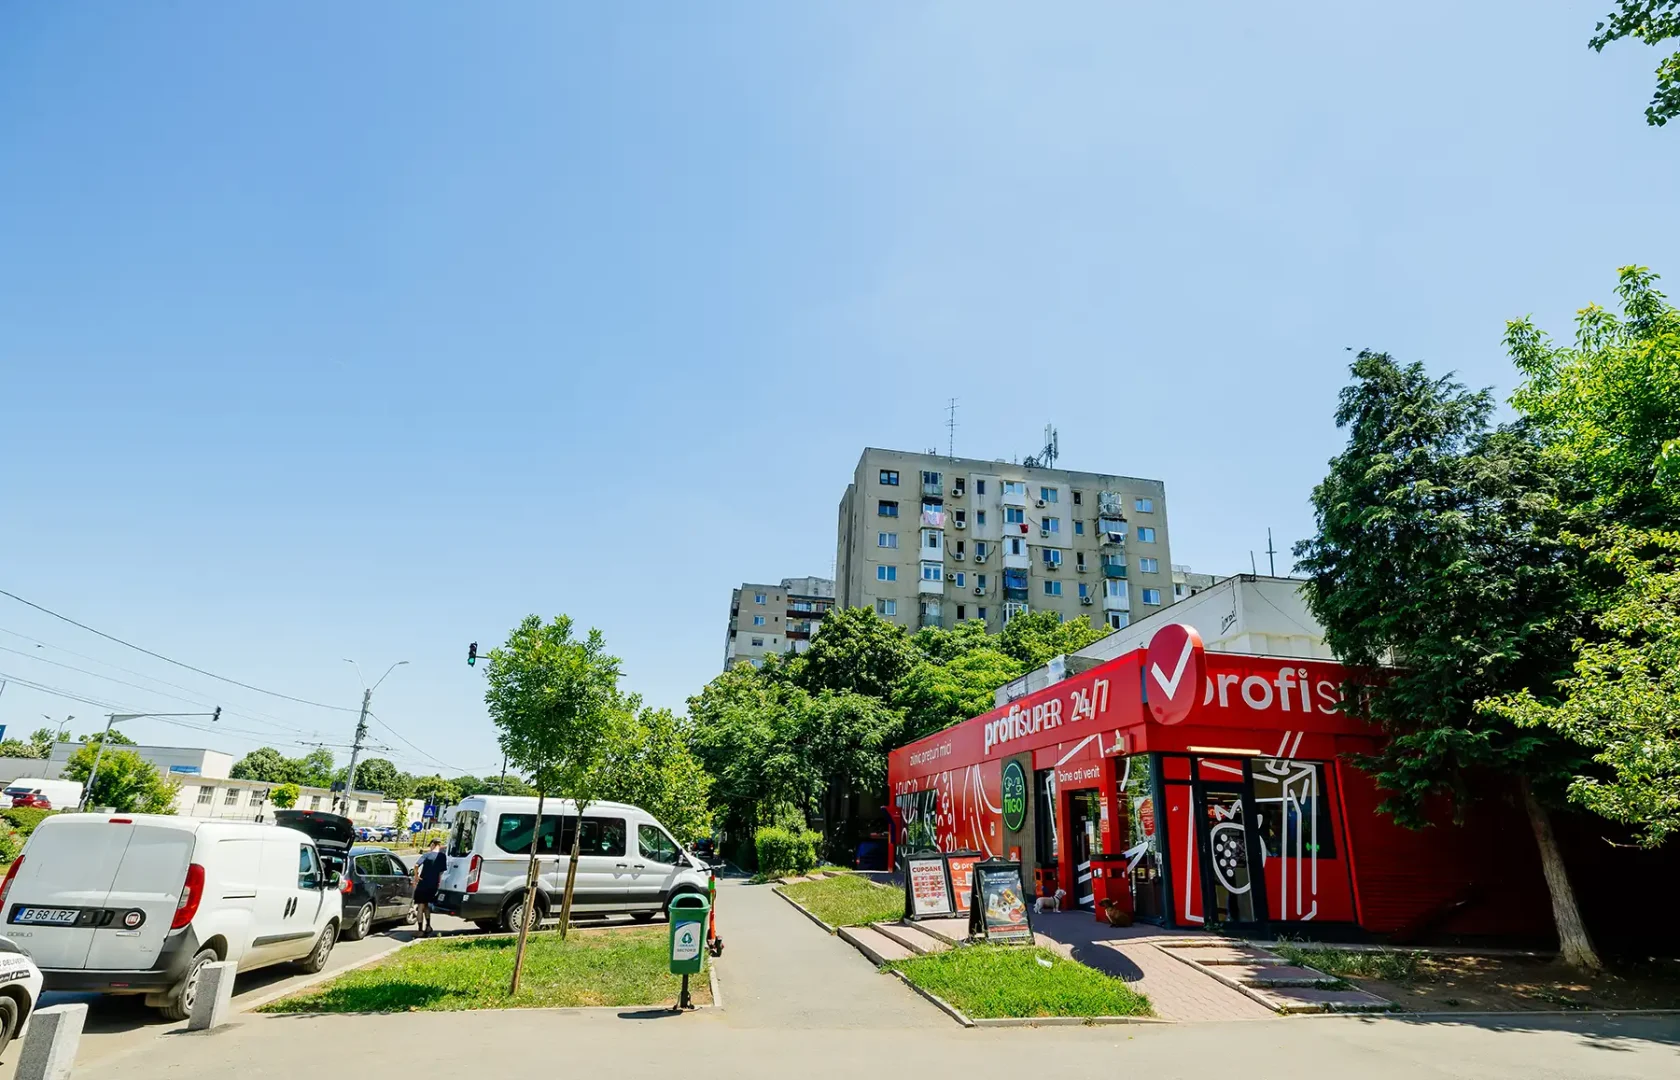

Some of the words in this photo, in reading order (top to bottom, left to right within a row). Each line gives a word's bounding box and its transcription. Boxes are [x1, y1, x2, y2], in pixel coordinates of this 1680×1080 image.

[984, 698, 1063, 755] profiSUPER
[1070, 679, 1109, 722] 24/7
[940, 739, 952, 758] mici
[1083, 764, 1101, 779] venit
[24, 909, 33, 920] B
[35, 909, 49, 920] 68
[50, 910, 75, 921] LRZ
